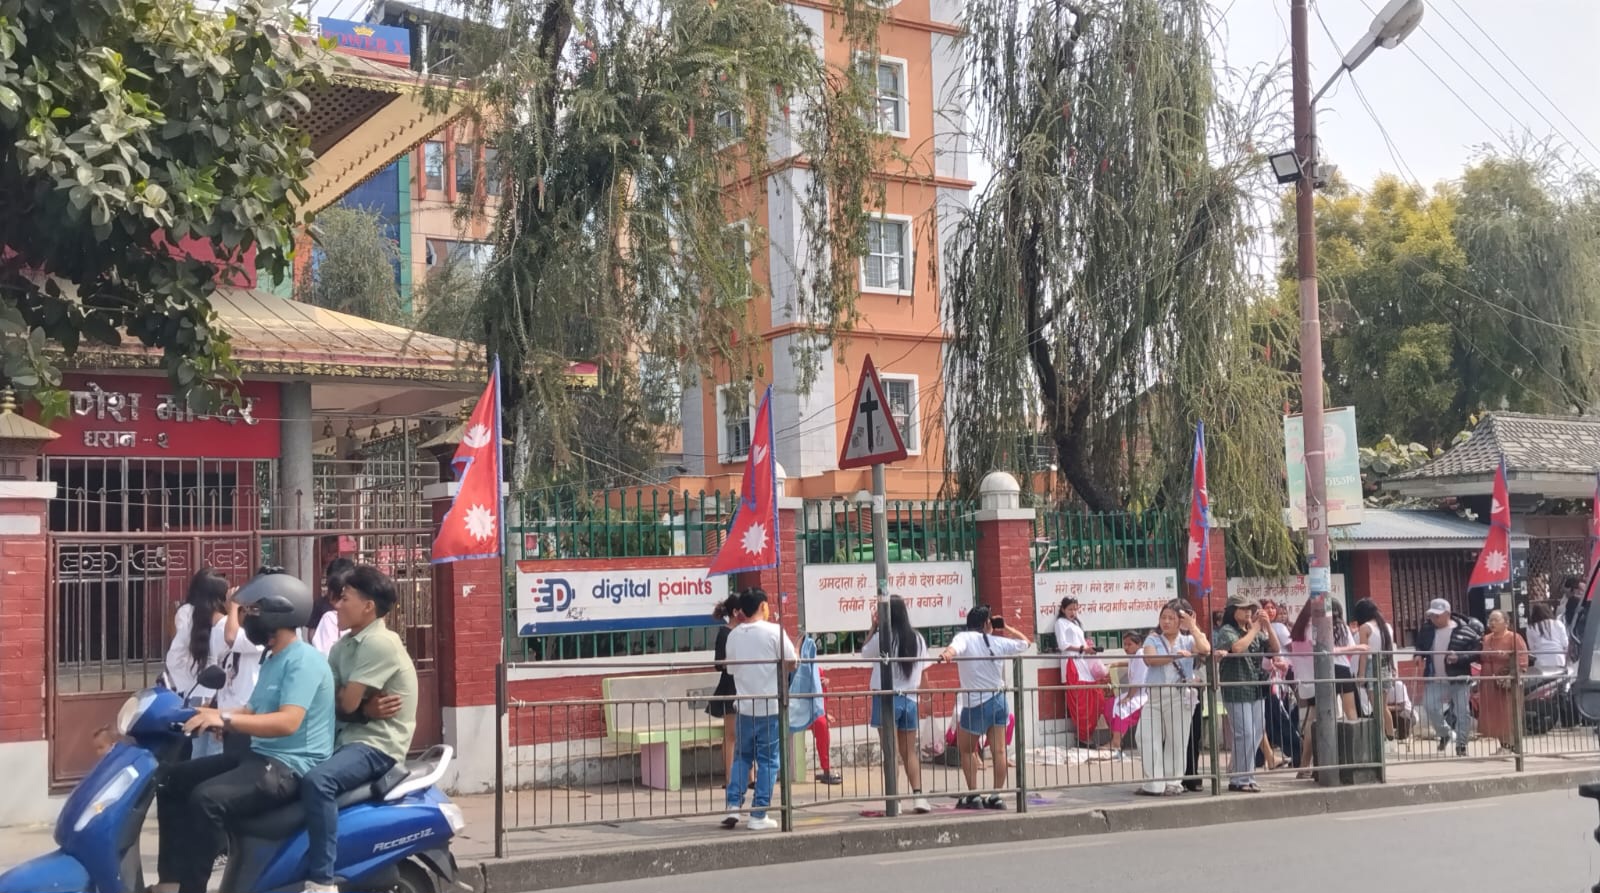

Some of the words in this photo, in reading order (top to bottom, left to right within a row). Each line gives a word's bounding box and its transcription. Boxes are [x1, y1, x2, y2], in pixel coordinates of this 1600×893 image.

[70, 381, 142, 423] णेश
[591, 578, 651, 604] digital
[658, 576, 713, 604] paints
[920, 572, 934, 588] देश
